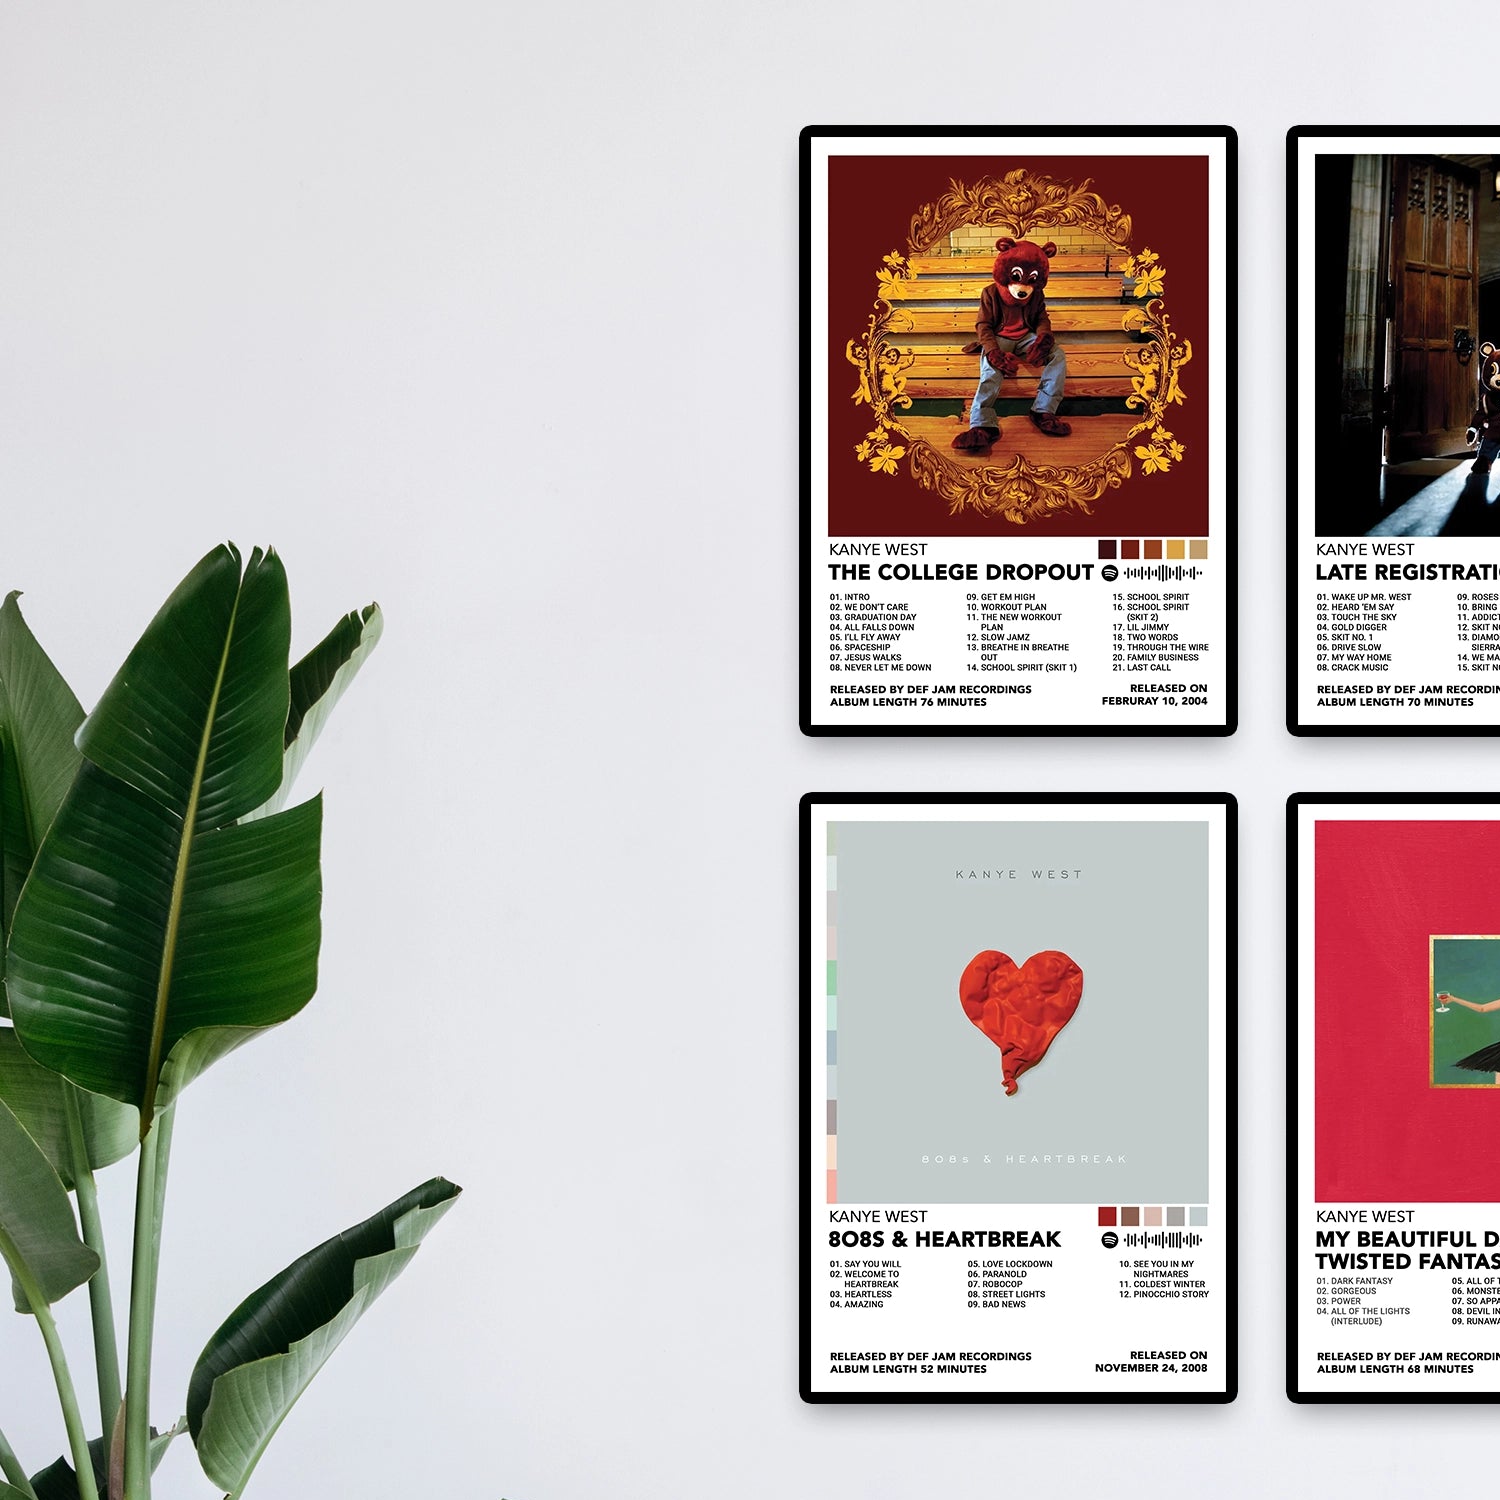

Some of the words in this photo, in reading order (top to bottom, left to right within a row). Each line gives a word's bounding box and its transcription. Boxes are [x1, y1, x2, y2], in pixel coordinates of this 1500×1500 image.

[829, 543, 881, 556] KANYE
[884, 543, 929, 556] WEST
[1316, 543, 1368, 556] KANYE
[1371, 543, 1416, 556] WEST
[828, 564, 870, 580] THE
[878, 564, 978, 580] COLLEGE
[987, 564, 1094, 580] DROPOUT
[1317, 564, 1367, 580] LATE
[829, 593, 843, 601] 01.
[844, 592, 871, 601] INTRO
[1112, 593, 1125, 601] 15.
[1126, 593, 1162, 601] SCHOOL
[1162, 592, 1190, 601] SPIRIT
[1456, 593, 1470, 601] 09.
[1471, 592, 1500, 601] ROSES
[1316, 603, 1330, 612] 02.
[1331, 602, 1360, 611] HEARD
[1378, 603, 1395, 611] SAY
[829, 633, 843, 642] 05.
[860, 633, 876, 642] FLY
[876, 633, 901, 641] AWAY
[830, 684, 887, 694] RELEASED
[889, 684, 905, 694] BY
[907, 685, 929, 694] DEF
[931, 685, 956, 694] JAM
[959, 684, 1032, 695] RECORDINGS
[1130, 683, 1187, 693] RELEASED
[1189, 683, 1208, 693] ON
[829, 697, 870, 707] ALBUM
[872, 697, 918, 707] LENGTH
[920, 697, 934, 707] 76
[936, 697, 987, 707] MINUTES
[1101, 696, 1160, 706] FEBRURAY
[1162, 696, 1179, 707] 10,
[1181, 696, 1208, 706] 2004
[955, 869, 1017, 880] KANYE
[1031, 869, 1082, 880] WEST
[983, 1154, 991, 1164] &
[1006, 1154, 1126, 1164] HEARTBREAK
[829, 1210, 881, 1223] KANYE
[884, 1210, 929, 1223] WEST
[1316, 1210, 1368, 1223] KANYE
[1371, 1209, 1416, 1223] WEST
[892, 1231, 908, 1247] &
[916, 1231, 1061, 1247] HEARTBREAK
[1317, 1231, 1350, 1247] MY
[1358, 1231, 1476, 1247] BEAUTIFUL
[967, 1259, 981, 1268] 05.
[982, 1260, 1004, 1268] LOVE
[1005, 1260, 1053, 1268] LOCKDOWN
[1315, 1253, 1411, 1269] TWISTED
[967, 1270, 981, 1278] 06.
[1133, 1269, 1189, 1278] NIGHTMARES
[1316, 1277, 1329, 1285] 01.
[1331, 1276, 1354, 1285] DARK
[1355, 1276, 1394, 1285] FANTASY
[1119, 1290, 1132, 1299] 12.
[1133, 1290, 1181, 1299] PINOCCHIO
[1181, 1290, 1210, 1299] STORY
[1316, 1286, 1329, 1295] 02.
[1330, 1286, 1377, 1295] GORGEOUS
[829, 1300, 843, 1309] 04.
[844, 1300, 884, 1309] AMAZING
[1451, 1297, 1465, 1305] 07.
[1466, 1296, 1479, 1305] SO
[1330, 1316, 1383, 1327] (INTERLUDE)
[1317, 1351, 1374, 1362] RELEASED
[1376, 1352, 1392, 1361] BY
[1394, 1352, 1417, 1361] DEF
[1418, 1352, 1443, 1361] JAM
[1095, 1363, 1159, 1373] NOVEMBER
[1161, 1363, 1179, 1374] 24,
[1181, 1363, 1208, 1373] 2008
[1316, 1364, 1357, 1374] ALBUM
[1359, 1364, 1405, 1374] LENGTH
[1407, 1364, 1421, 1374] 68
[1423, 1364, 1474, 1374] MINUTES
